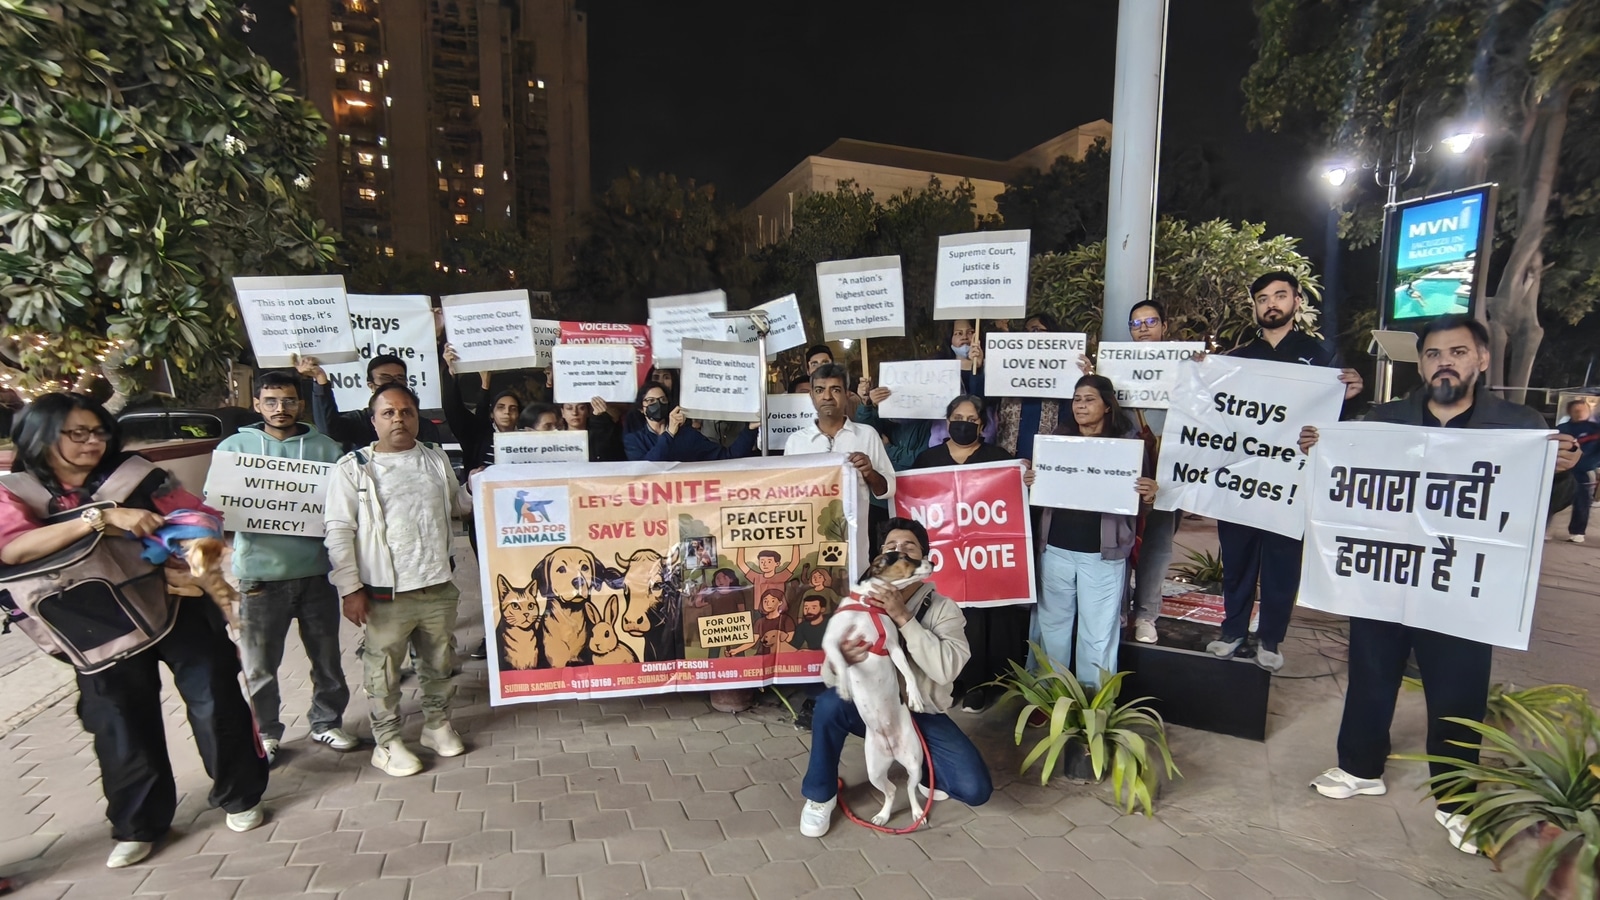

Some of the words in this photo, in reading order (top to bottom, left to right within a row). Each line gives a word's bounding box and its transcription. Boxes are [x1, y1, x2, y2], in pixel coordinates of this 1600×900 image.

[1408, 216, 1459, 238] MVN
[948, 249, 987, 259] Supreme
[988, 247, 1016, 256] Court,
[1408, 243, 1466, 259] BALCONY
[962, 263, 991, 273] justice
[992, 262, 1000, 270] is
[838, 277, 849, 285] "A
[850, 274, 883, 284] nation's
[950, 276, 1001, 287] compassion
[1002, 276, 1012, 285] in
[835, 290, 865, 300] highest
[866, 287, 888, 297] court
[965, 291, 994, 300] action.
[251, 298, 276, 307] "This
[278, 298, 286, 306] is
[288, 298, 305, 306] not
[307, 297, 336, 305] about
[832, 305, 852, 313] must
[853, 301, 883, 313] protect
[884, 300, 894, 308] its
[261, 313, 287, 322] liking
[289, 312, 315, 322] dogs,
[317, 311, 332, 319] it's
[453, 310, 495, 322] "Supreme
[495, 310, 522, 319] Court,
[834, 318, 855, 326] most
[855, 313, 894, 325] helpless."
[350, 312, 400, 334] Strays
[454, 327, 465, 336] be
[466, 326, 481, 335] the
[481, 324, 505, 333] voice
[505, 323, 524, 332] they
[578, 322, 632, 333] VOICELESS,
[262, 327, 289, 336] about
[290, 325, 339, 336] upholding
[769, 327, 786, 336] liars
[283, 339, 321, 351] justice."
[462, 338, 492, 348] cannot
[492, 335, 519, 346] have."
[987, 339, 1024, 350] DOGS
[1027, 339, 1084, 351] DESERVE
[572, 359, 586, 367] put
[691, 356, 723, 367] "Justice
[723, 359, 756, 369] without
[1002, 358, 1036, 369] LOVE
[1038, 359, 1067, 370] NOT
[329, 372, 362, 389] Not
[698, 372, 724, 381] mercy
[724, 372, 732, 381] is
[732, 374, 747, 382] not
[1131, 369, 1164, 381] NOT
[572, 380, 596, 388] power
[694, 383, 722, 394] justice
[1010, 377, 1057, 389] CAGES!
[1113, 389, 1171, 402] EMOVA
[800, 411, 814, 419] for
[1213, 391, 1288, 426] Strays
[1180, 425, 1237, 452] Need
[500, 445, 539, 454] "Better
[540, 443, 583, 455] policies,
[235, 456, 331, 476] JUDGEMENT
[1035, 463, 1053, 472] "No
[1054, 464, 1079, 474] dogs
[1086, 466, 1101, 475] No
[1103, 468, 1137, 477] votes"
[244, 477, 318, 494] WITHOUT
[1172, 461, 1209, 484] Not
[1214, 466, 1284, 501] Cages
[579, 494, 623, 509] LET'S
[628, 479, 722, 506] UNITE
[727, 487, 761, 501] FOR
[765, 483, 840, 500] ANIMALS
[1328, 465, 1421, 514] अवारा
[220, 495, 298, 512] THOUGHT
[301, 502, 327, 515] AN
[727, 510, 808, 526] PEACEFUL
[910, 503, 945, 529] NO
[955, 499, 1008, 527] DOG
[246, 518, 305, 533] MERCY!
[501, 525, 540, 535] STAND
[542, 524, 566, 533] FOR
[588, 521, 636, 540] SAVE
[643, 519, 667, 537] US
[502, 532, 567, 545] ANIMALS
[730, 526, 806, 542] PROTEST
[953, 543, 1016, 571] VOTE
[1335, 535, 1426, 588] हमारा
[1430, 534, 1458, 593] है
[705, 618, 724, 627] FOR
[726, 615, 746, 625] OUR
[701, 623, 751, 636] COMMUNITY
[707, 632, 749, 644] ANIMALS
[641, 661, 676, 673] CONTACT
[677, 660, 709, 669] PERSON
[504, 683, 530, 693] SUDHIR
[530, 680, 566, 692] SACHDEVA
[616, 676, 637, 686] PROF.
[637, 673, 669, 684] SUBHASH
[743, 668, 764, 678] DEEPA
